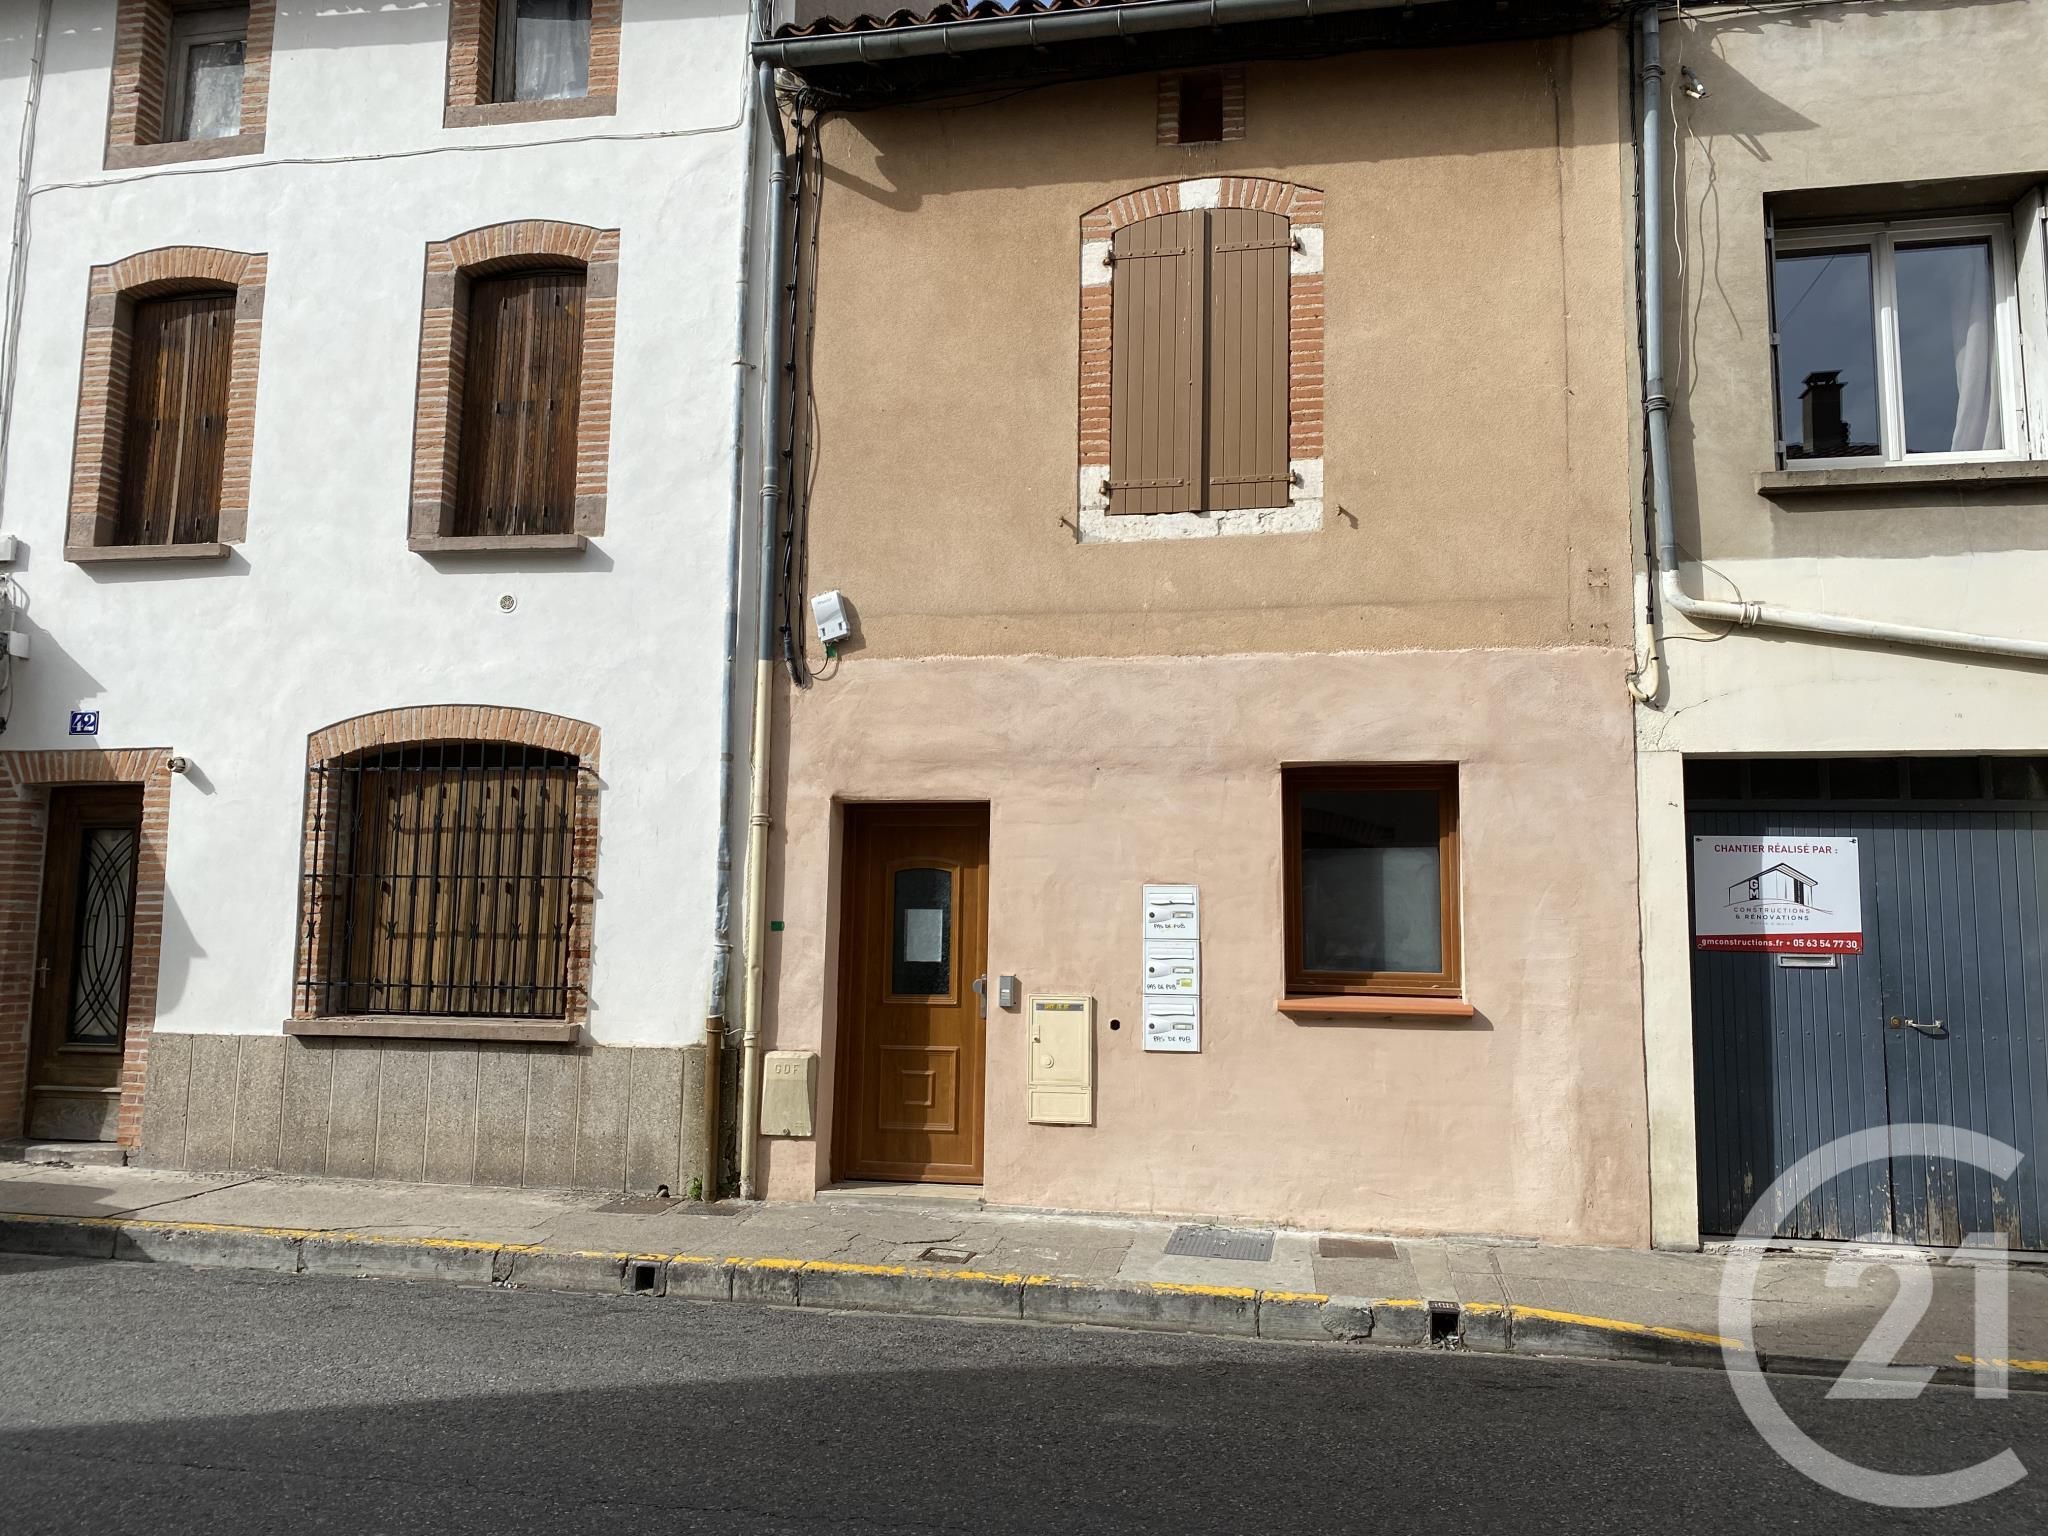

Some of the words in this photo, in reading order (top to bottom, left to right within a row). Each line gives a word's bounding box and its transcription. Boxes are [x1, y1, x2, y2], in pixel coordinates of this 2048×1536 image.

[71, 713, 96, 732] 42
[1714, 844, 1765, 854] CHANTIER
[1767, 842, 1810, 854] RÉALISÉ
[1812, 845, 1832, 854] PAR
[1744, 913, 1809, 921] RÉNOVATIONS
[1701, 938, 1784, 947] gmconstructions.fr
[1792, 938, 1805, 947] 05
[1806, 939, 1818, 948] 63
[1819, 939, 1831, 948] 54
[1832, 939, 1844, 948] 77
[1846, 940, 1858, 949] 30
